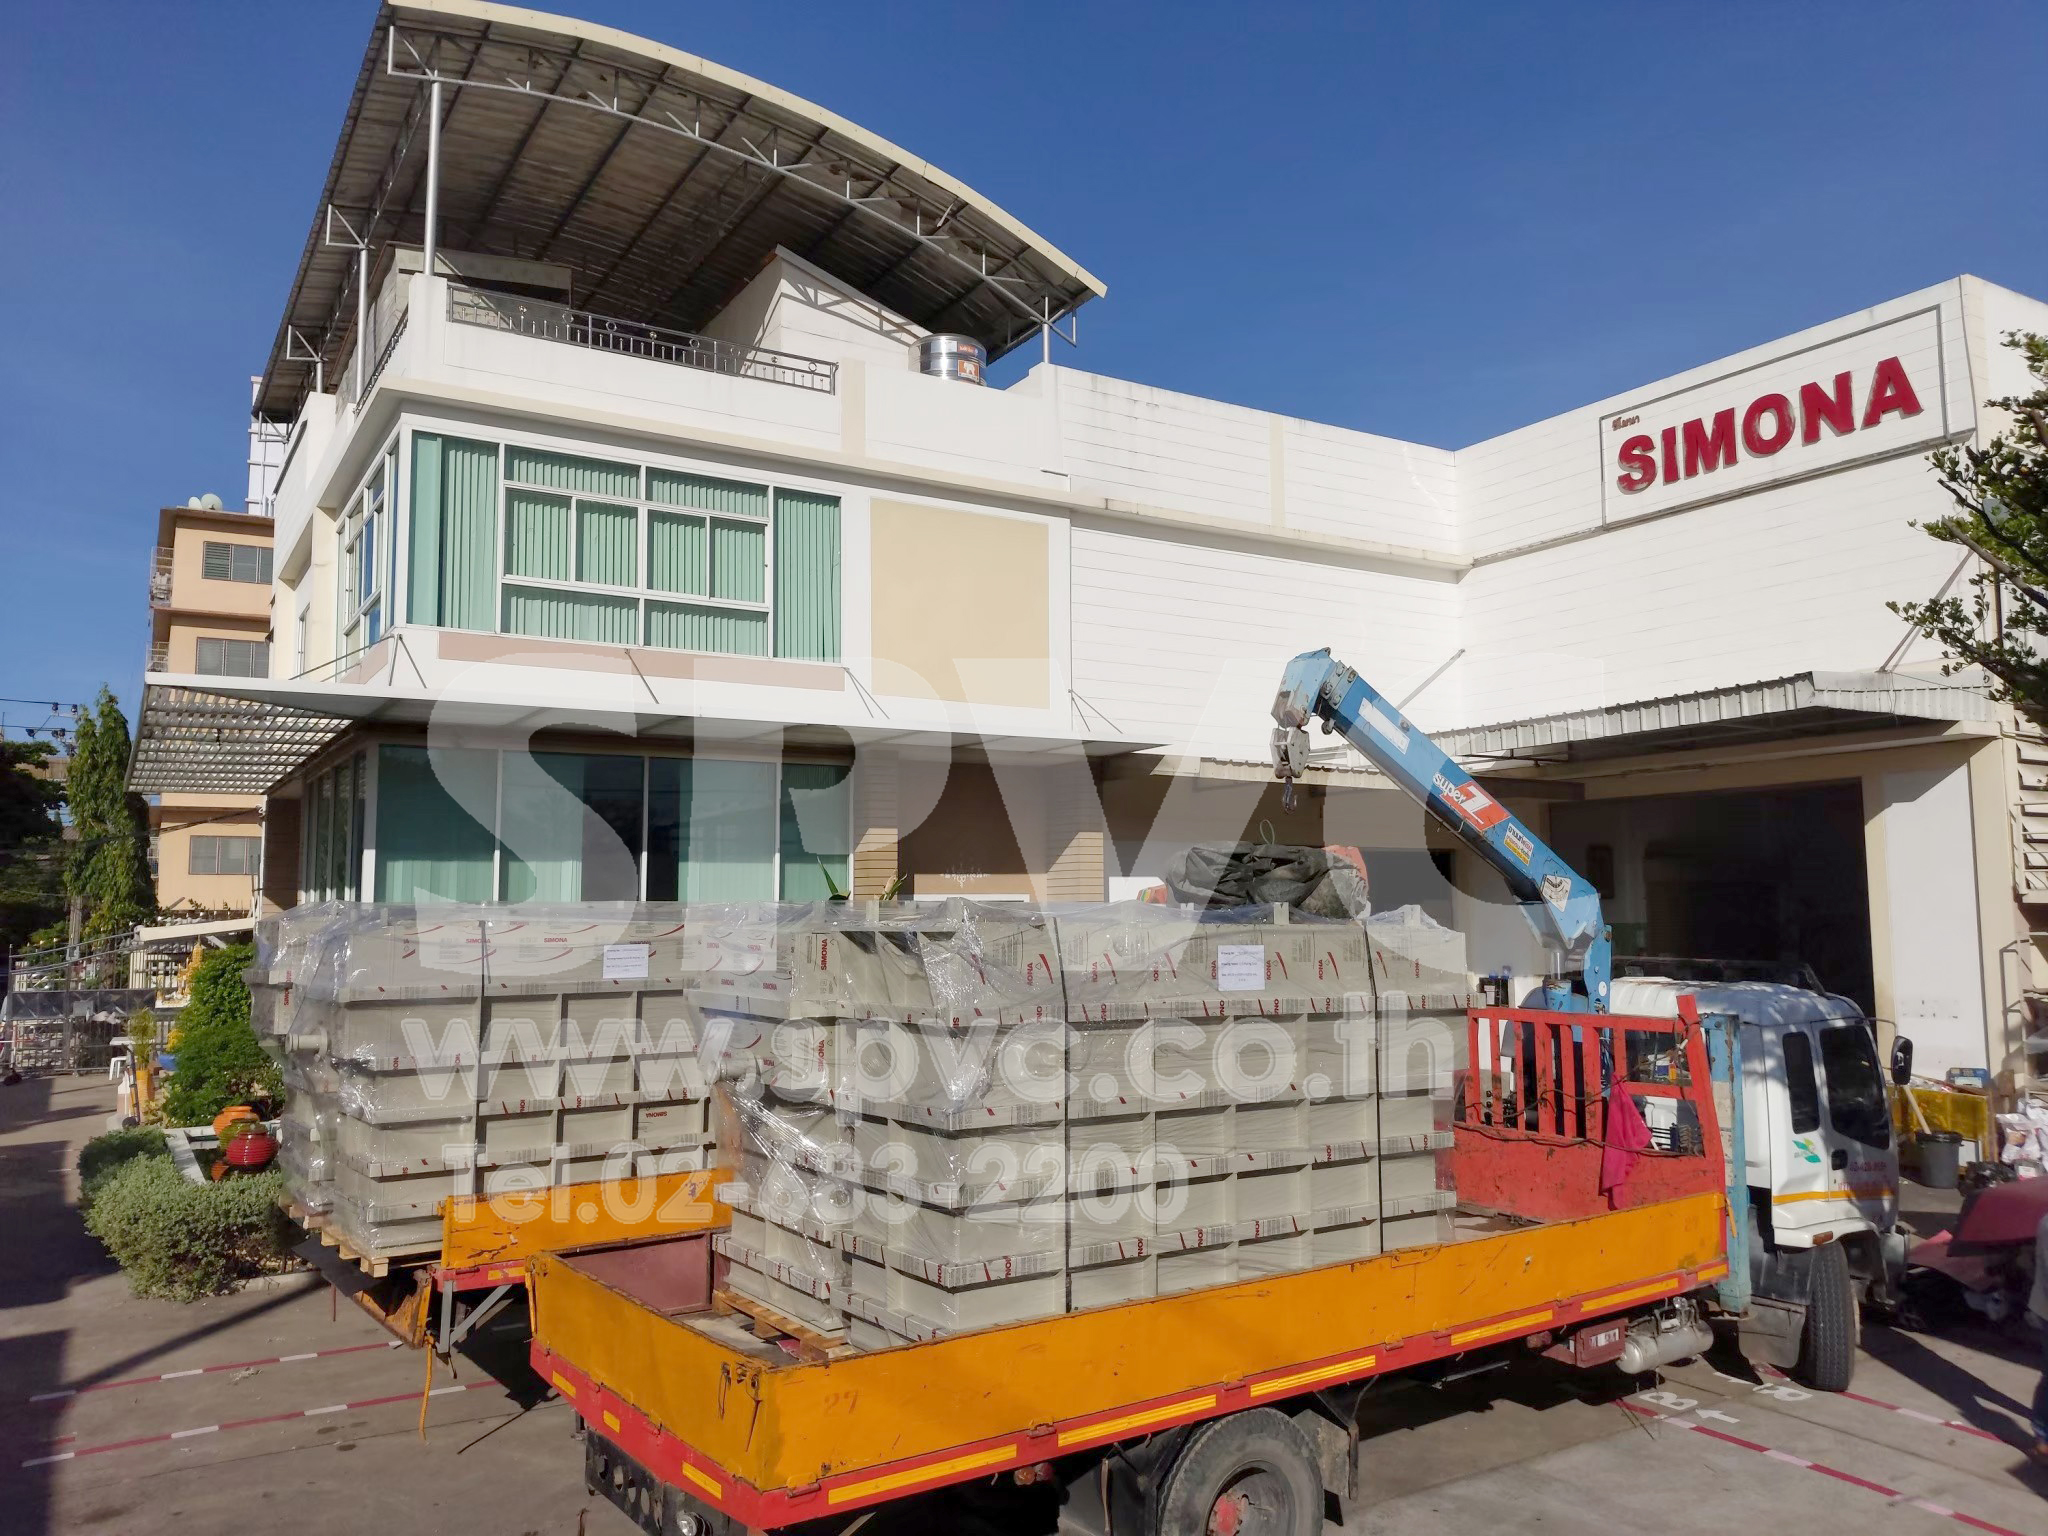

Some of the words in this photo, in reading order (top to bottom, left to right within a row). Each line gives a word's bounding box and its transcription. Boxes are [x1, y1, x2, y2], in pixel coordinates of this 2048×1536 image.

[1617, 356, 1924, 492] SIMONA
[820, 938, 828, 971] SIMONA
[646, 1110, 668, 1119] SIMONA
[1639, 1391, 1698, 1410] B
